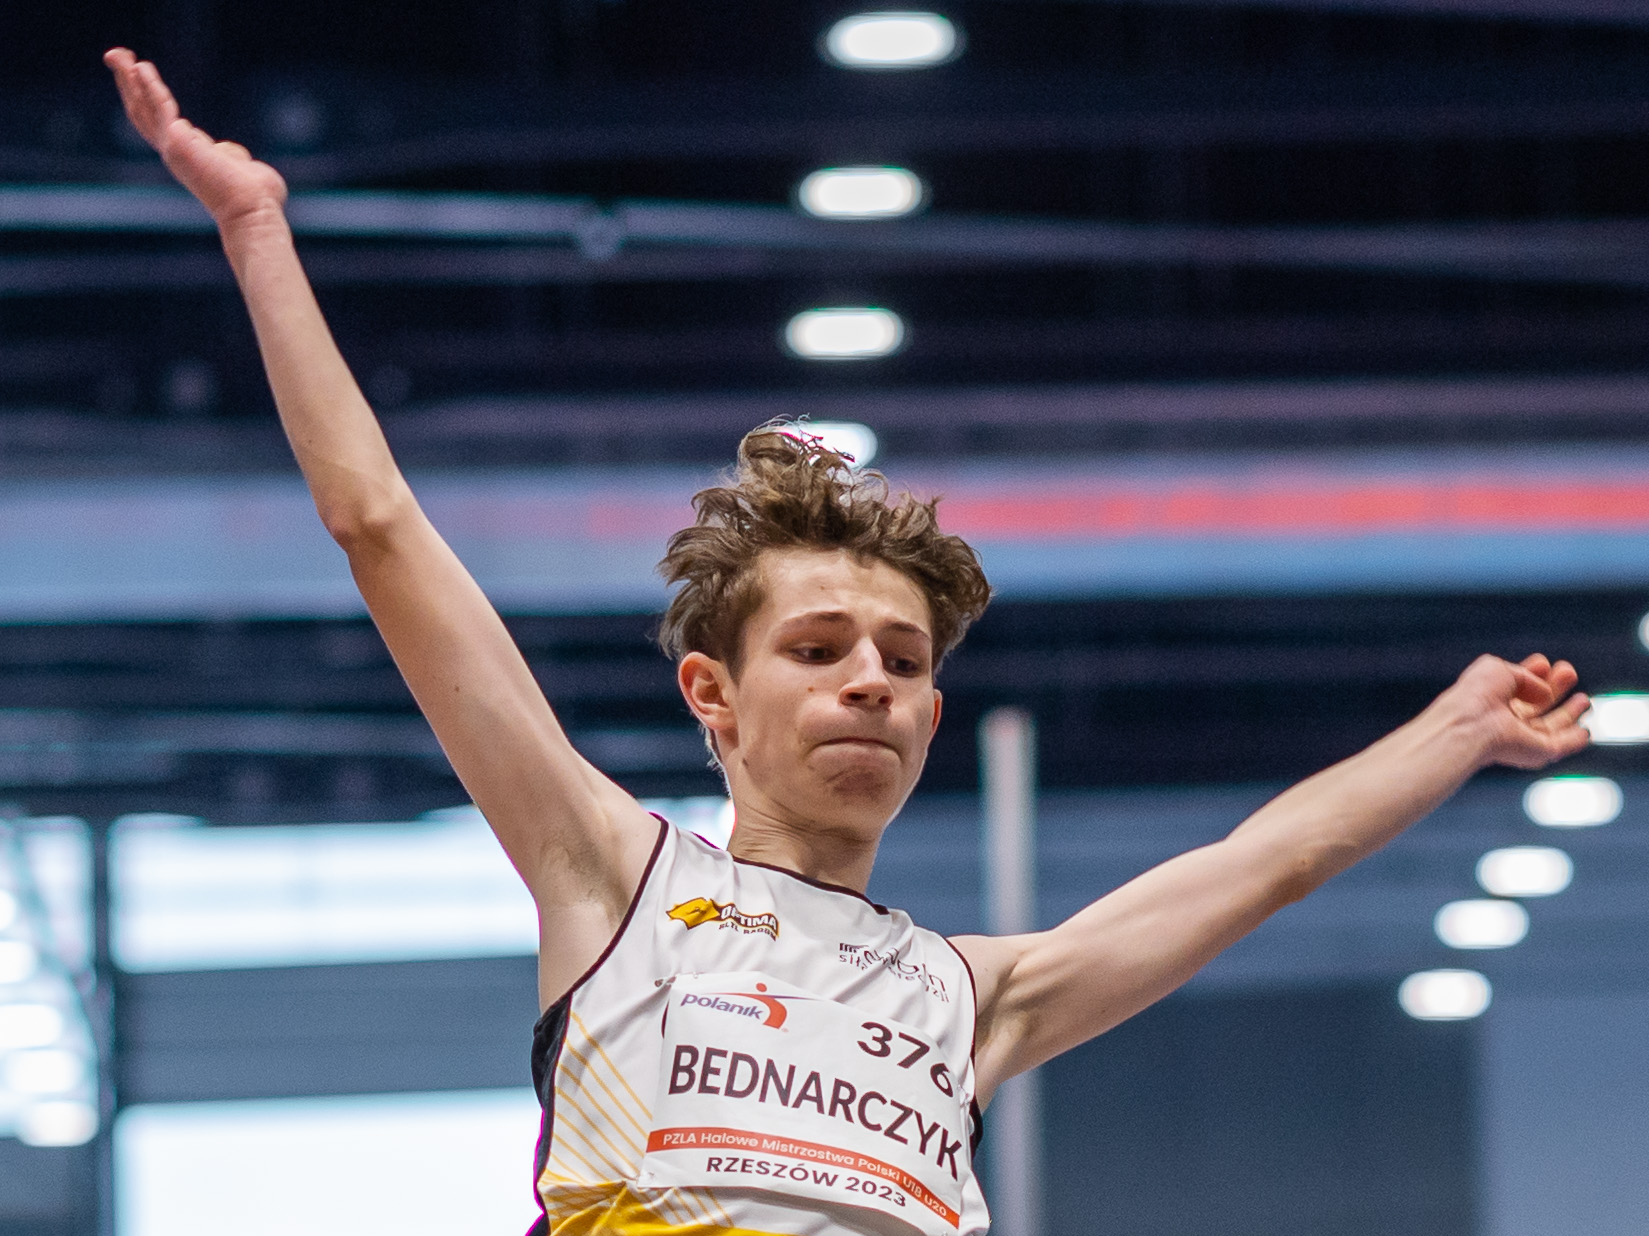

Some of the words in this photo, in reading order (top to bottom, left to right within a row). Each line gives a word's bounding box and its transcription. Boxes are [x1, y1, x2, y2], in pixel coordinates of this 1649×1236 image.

[680, 993, 764, 1020] polanik
[857, 1021, 954, 1098] 376
[668, 1044, 963, 1182] BEDNARCZYK
[663, 1133, 696, 1145] PZLA
[700, 1132, 758, 1147] Halowe
[762, 1139, 854, 1165] Mistrzostwa
[858, 1158, 900, 1181] Polski
[902, 1176, 922, 1198] U18
[924, 1195, 947, 1217] U20
[706, 1157, 839, 1187] RZESZÓW
[845, 1176, 906, 1207] 2023
